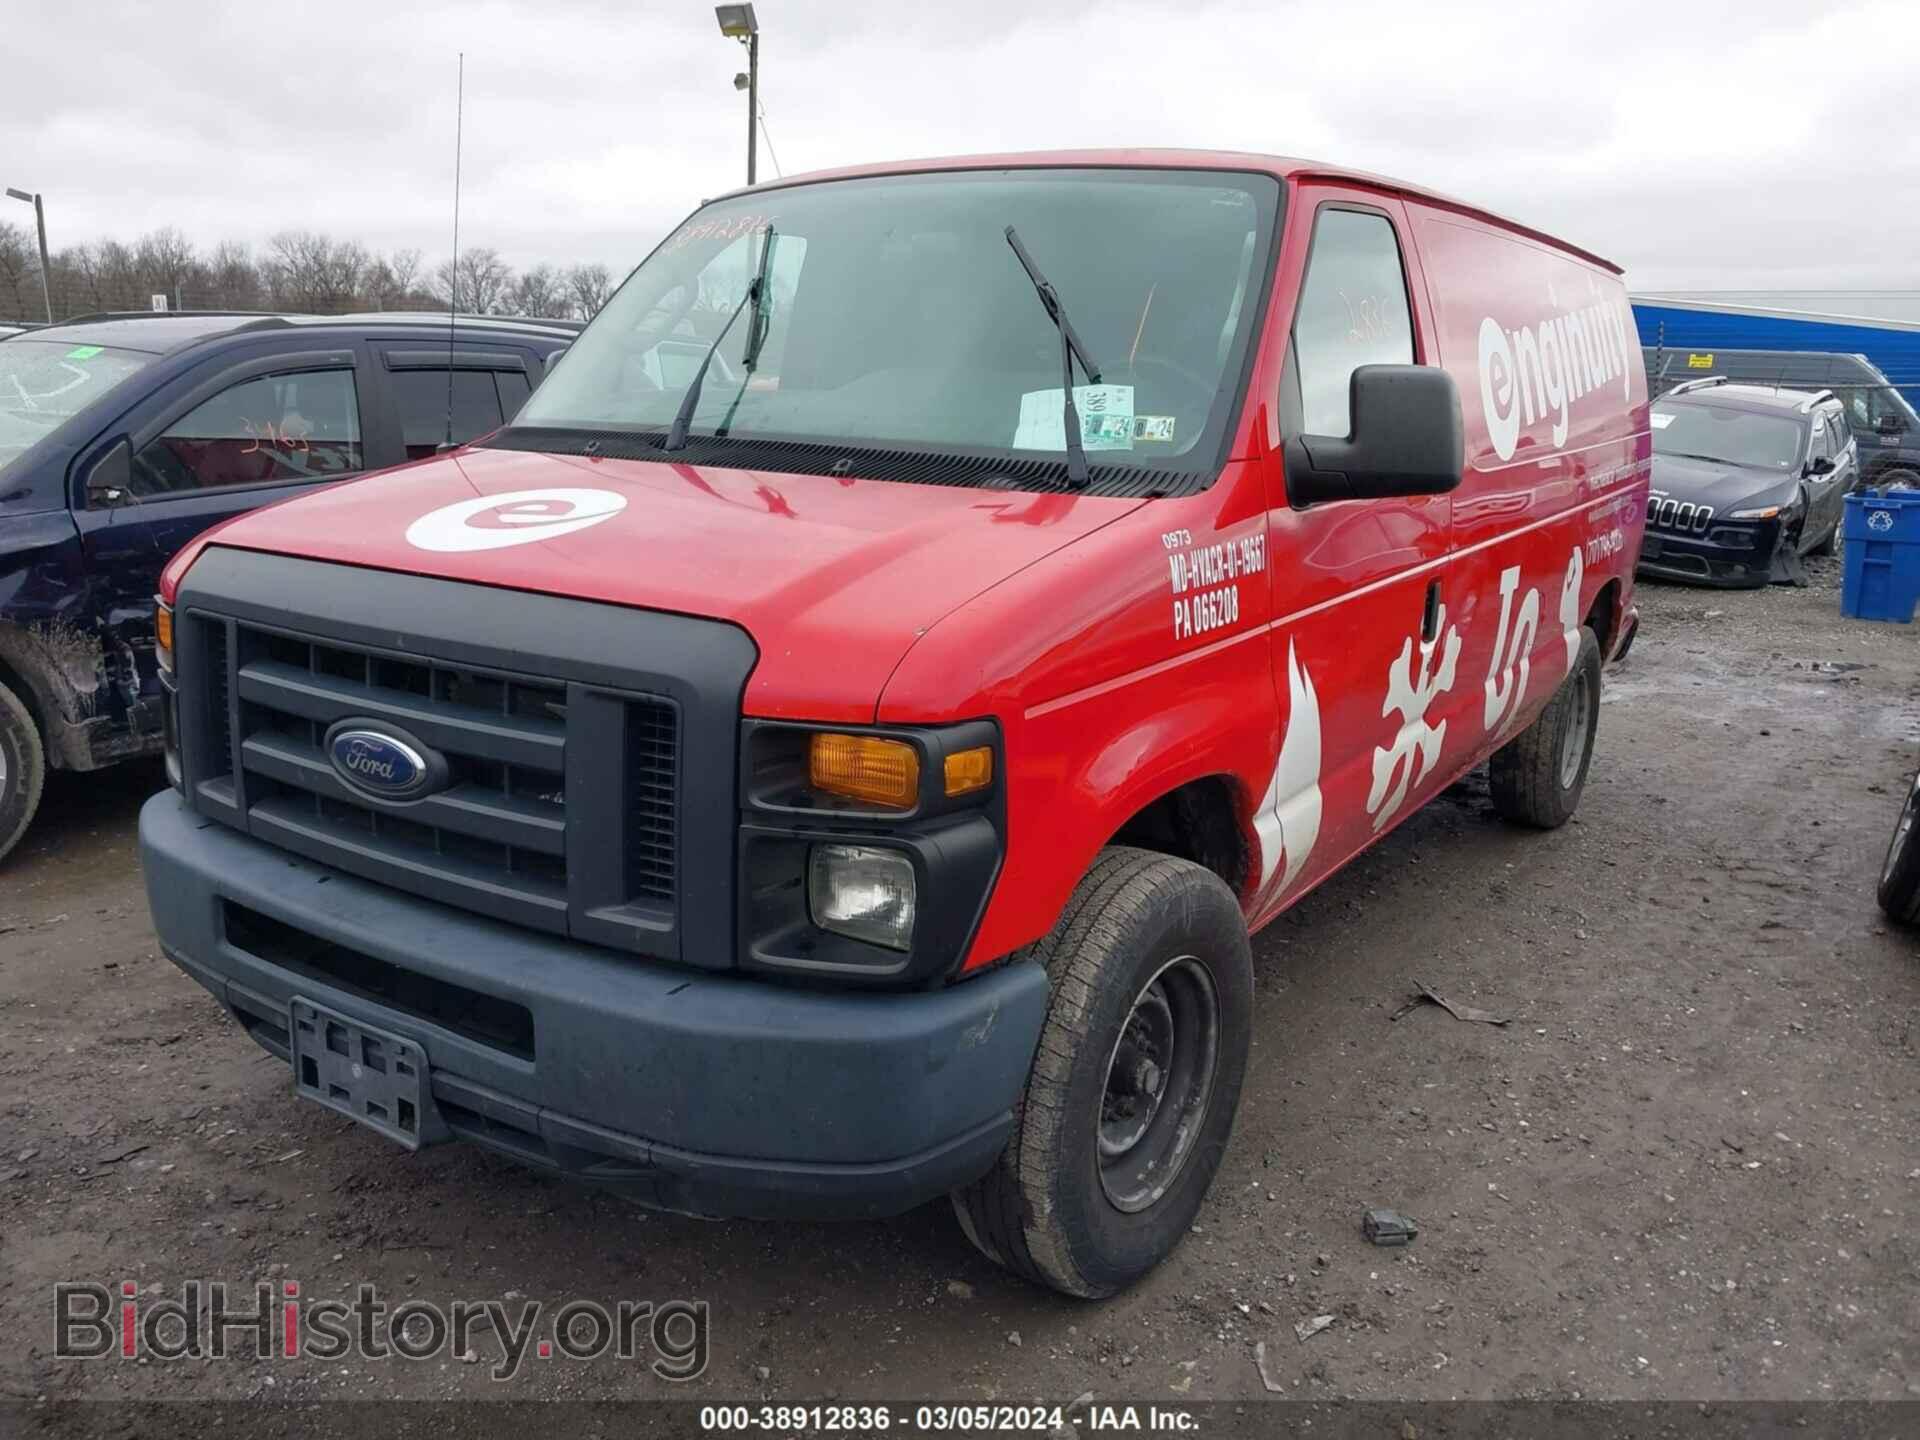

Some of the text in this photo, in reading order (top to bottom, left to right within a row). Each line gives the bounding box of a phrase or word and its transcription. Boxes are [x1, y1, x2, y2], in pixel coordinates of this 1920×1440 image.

[1159, 419, 1173, 437] 24
[1162, 529, 1192, 549] 0973
[1169, 534, 1265, 594] MD-HVACR-01-19667
[1174, 585, 1239, 640] PA 066208
[346, 740, 395, 778] Ford
